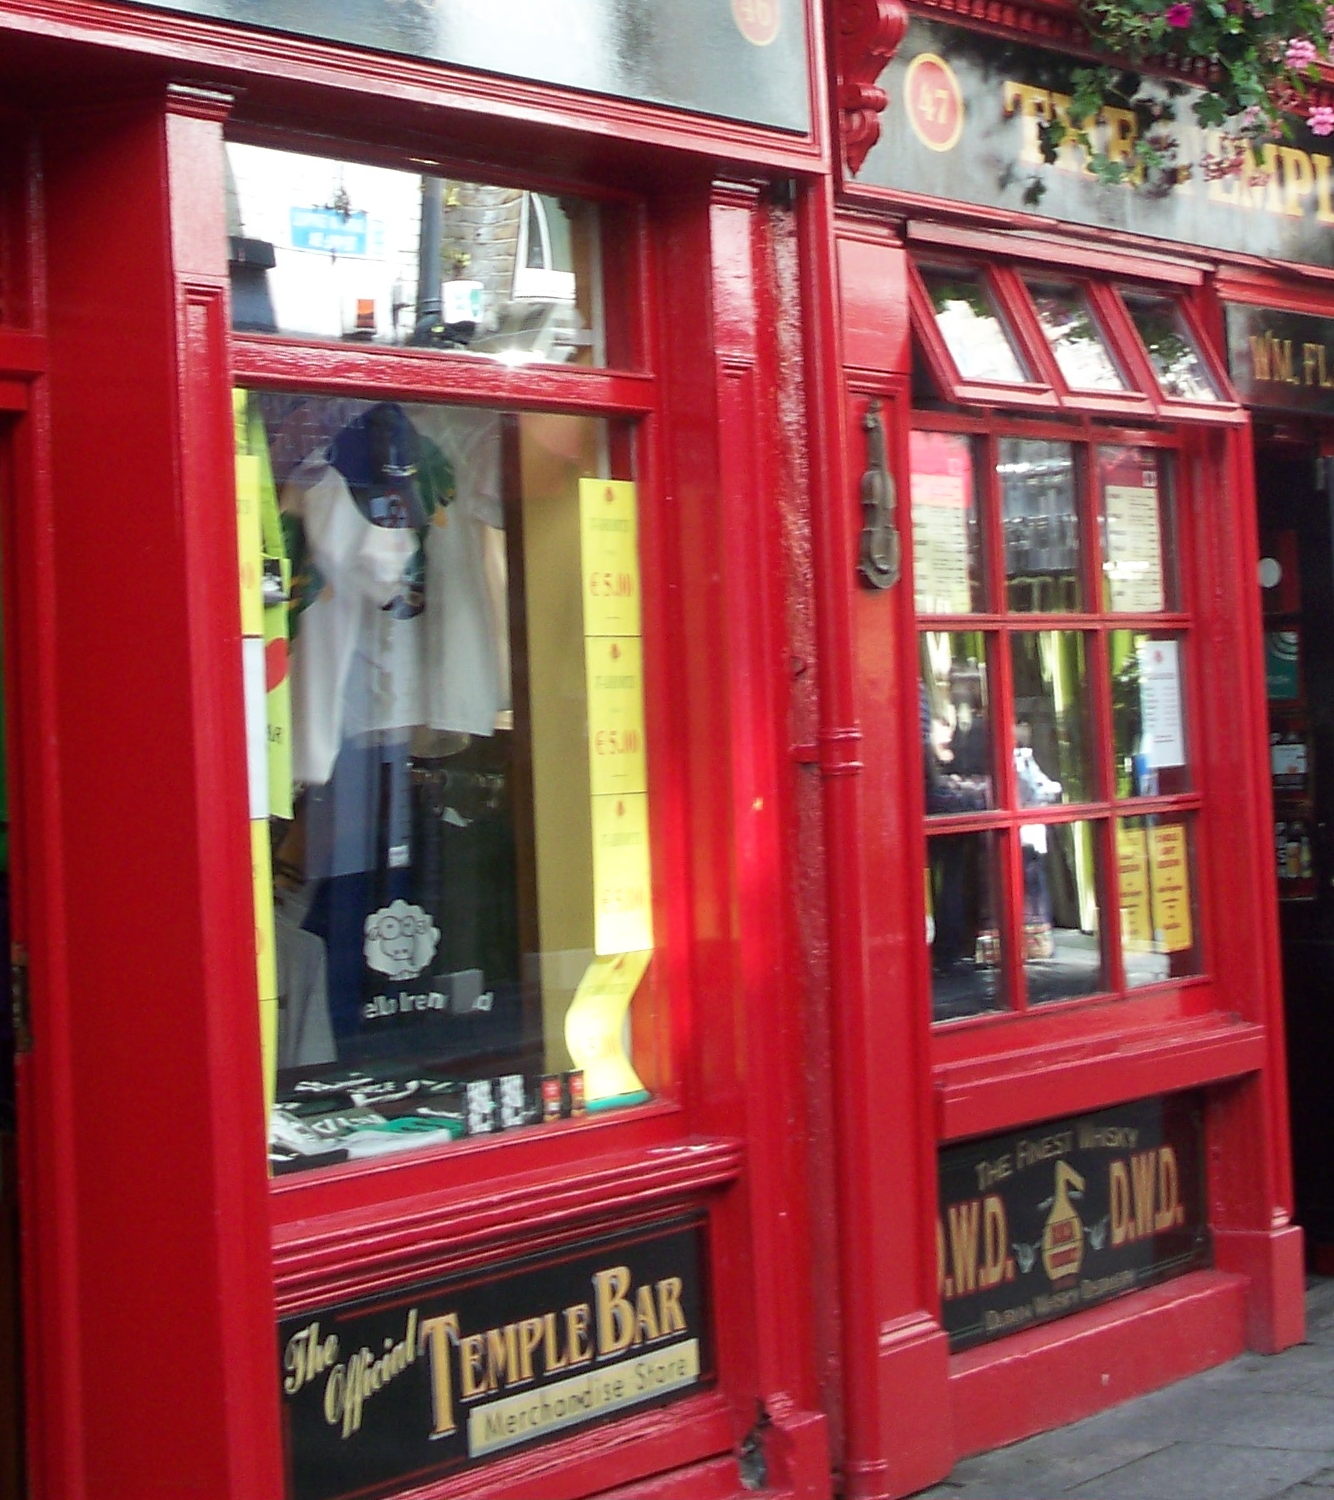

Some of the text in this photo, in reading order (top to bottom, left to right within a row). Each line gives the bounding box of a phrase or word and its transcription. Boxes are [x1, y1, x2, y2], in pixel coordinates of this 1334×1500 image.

[918, 81, 949, 125] 47
[937, 1194, 1015, 1300] .W.D.
[1109, 1145, 1186, 1249] D.W.D.
[282, 1320, 341, 1397] The
[323, 1307, 419, 1441] Official
[419, 1265, 689, 1441] TEMPLE BAR
[483, 1359, 689, 1443] Merchandise Store
